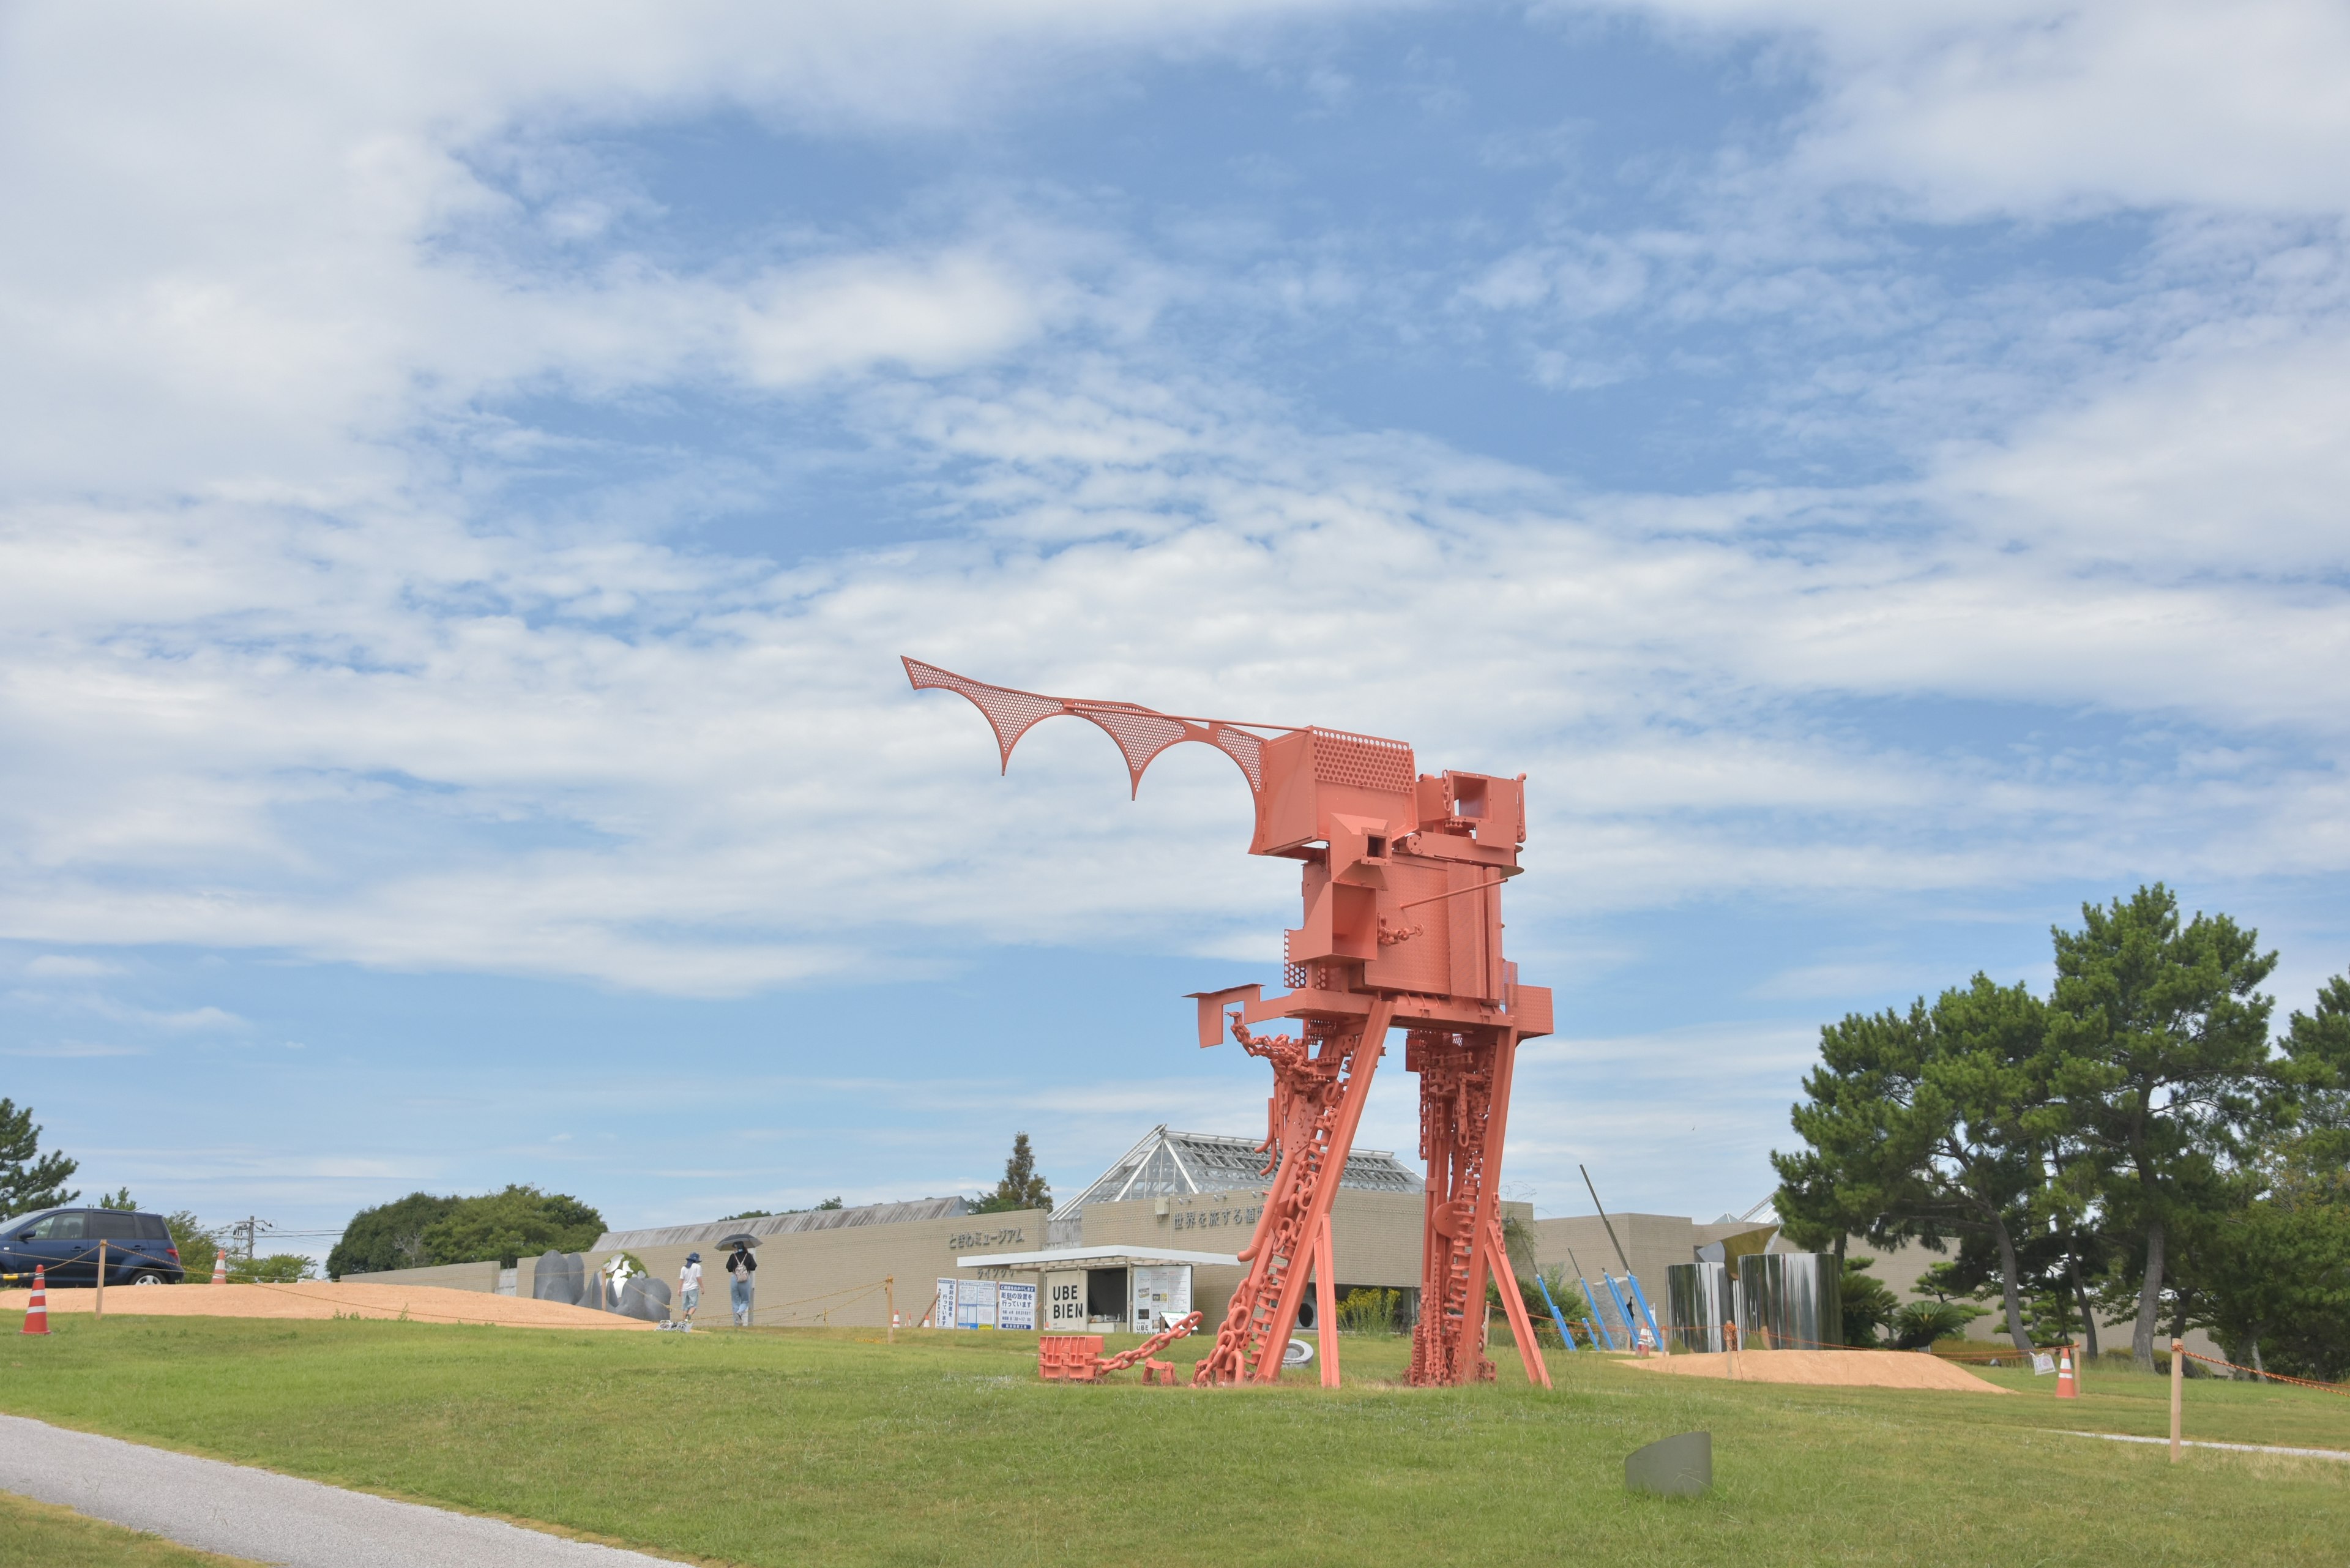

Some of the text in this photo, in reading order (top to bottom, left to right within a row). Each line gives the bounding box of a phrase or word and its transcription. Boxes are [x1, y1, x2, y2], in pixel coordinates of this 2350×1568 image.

[950, 1228, 1024, 1249] ときわミュージアム
[1001, 1292, 1033, 1301] 彫刻の設置を
[1053, 1285, 1078, 1301] UBE
[1053, 1303, 1083, 1319] BIEN
